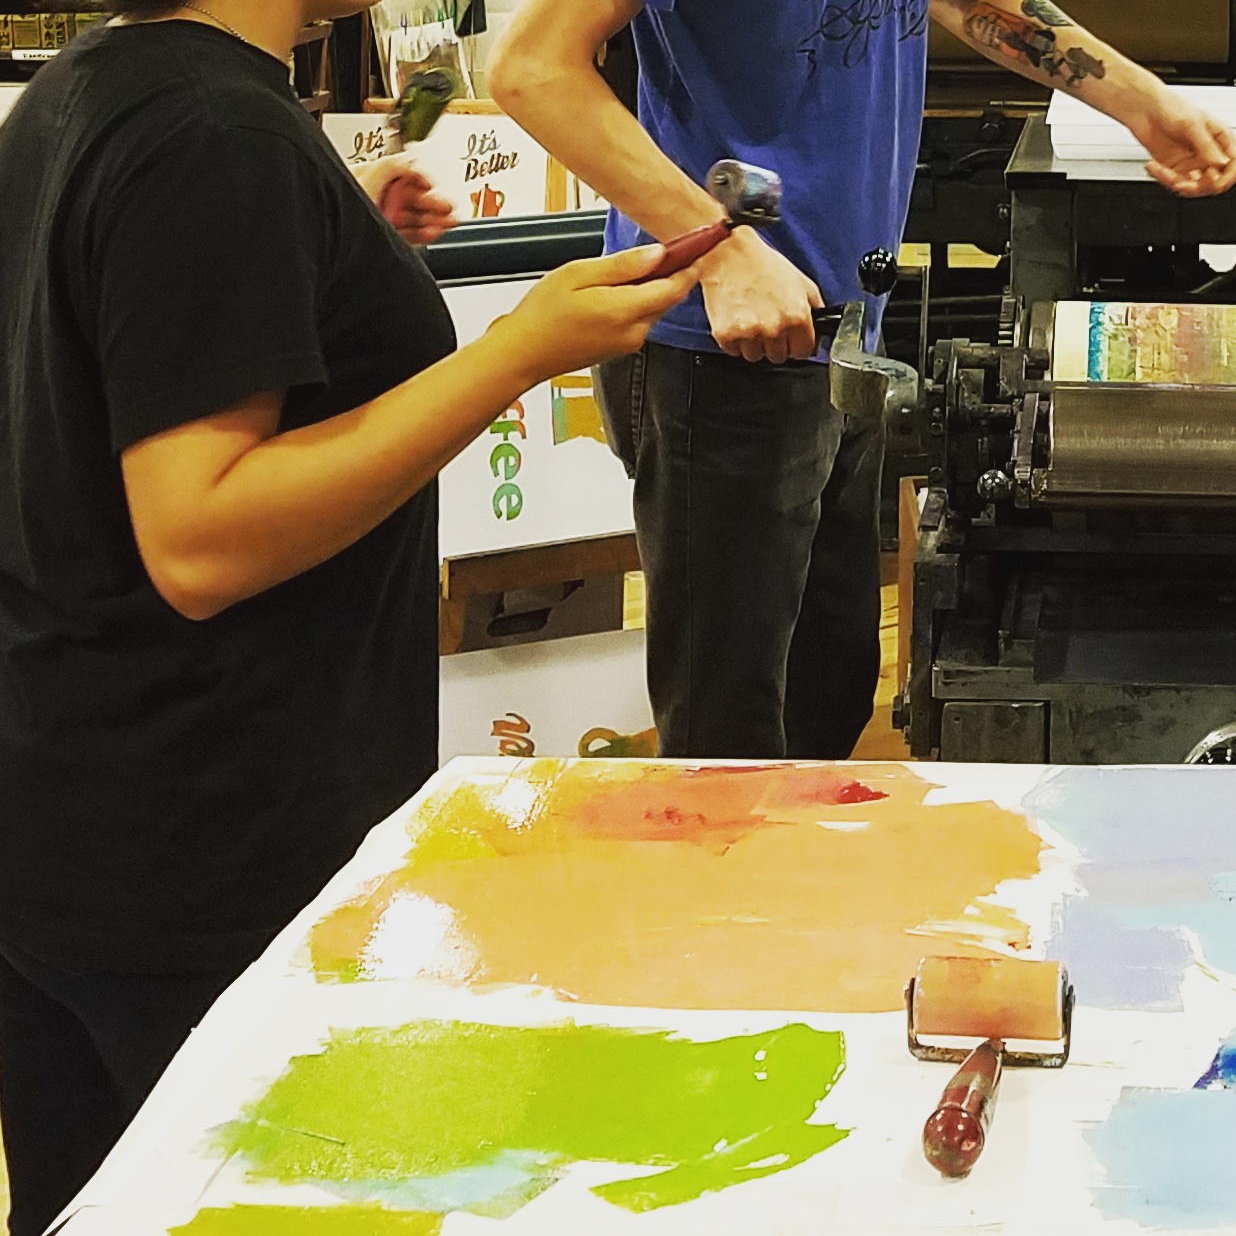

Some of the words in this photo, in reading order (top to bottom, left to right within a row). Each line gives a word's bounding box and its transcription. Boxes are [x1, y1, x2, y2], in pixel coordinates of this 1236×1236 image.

[347, 127, 385, 159] It's
[461, 129, 501, 160] It's
[465, 152, 520, 182] Better
